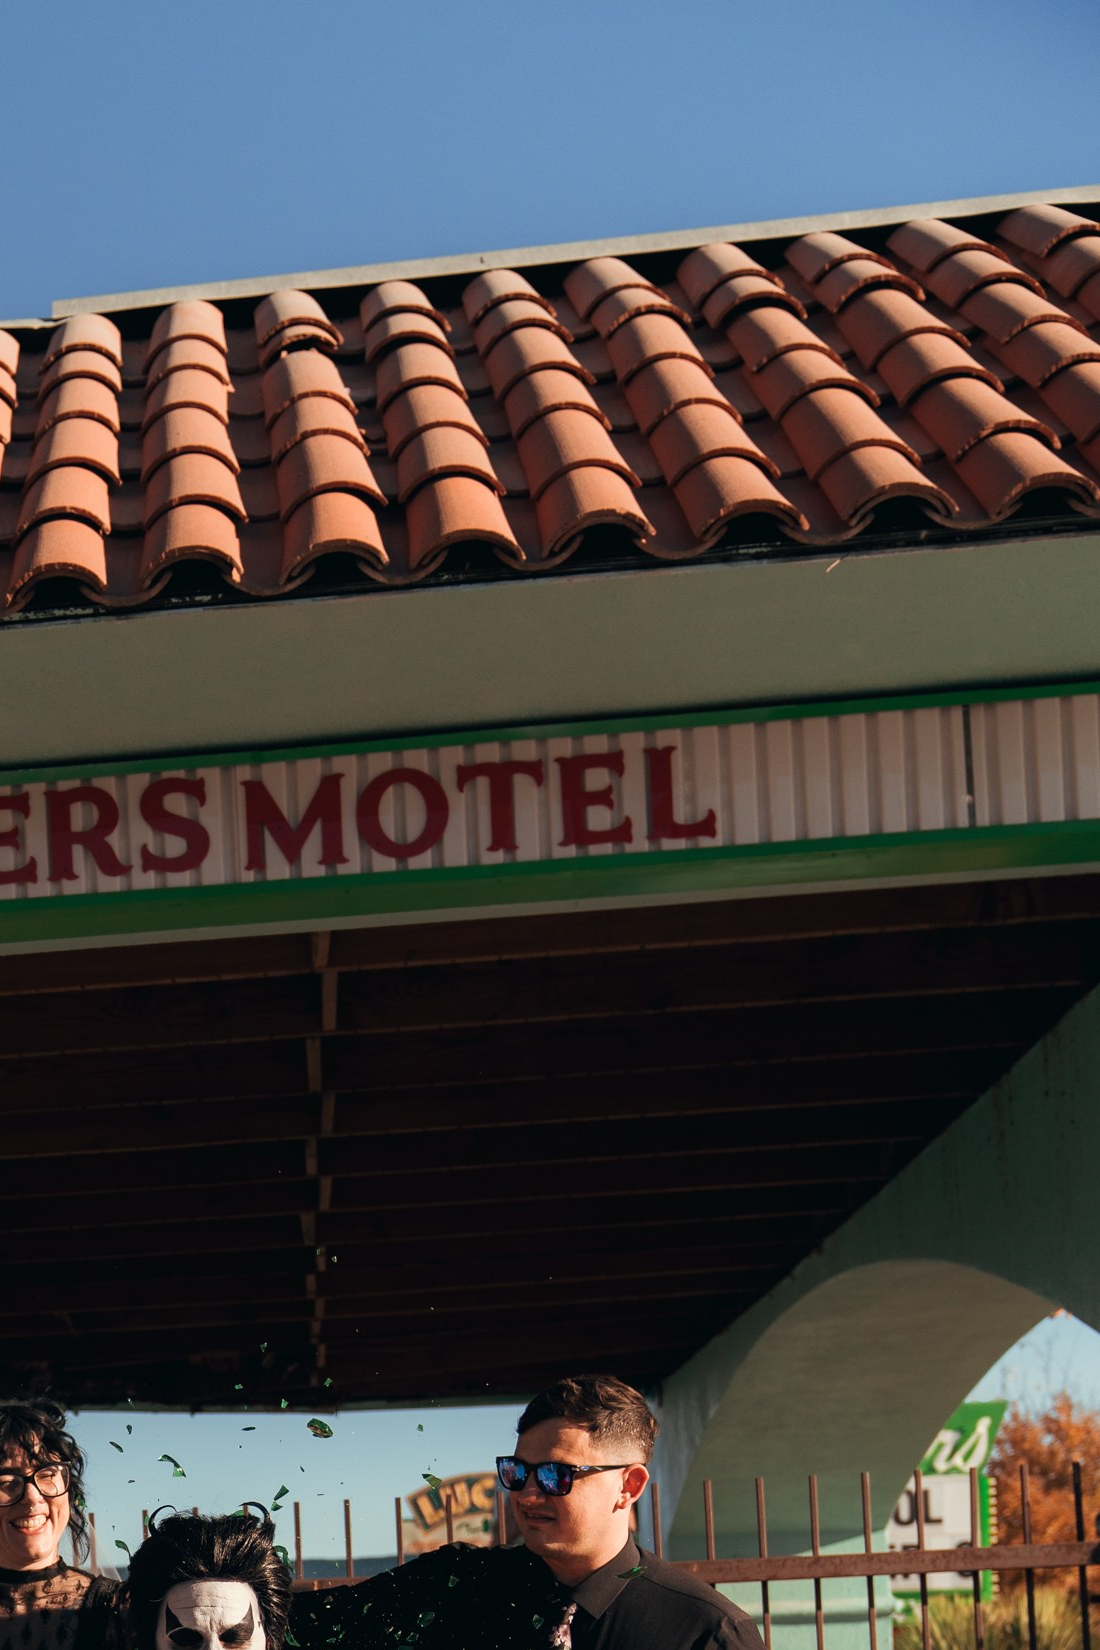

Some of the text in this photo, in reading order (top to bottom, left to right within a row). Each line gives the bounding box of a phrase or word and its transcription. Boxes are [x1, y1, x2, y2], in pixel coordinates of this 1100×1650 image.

[240, 745, 717, 872] MOTEL
[416, 1478, 496, 1527] LUC
[893, 1489, 942, 1526] OL
